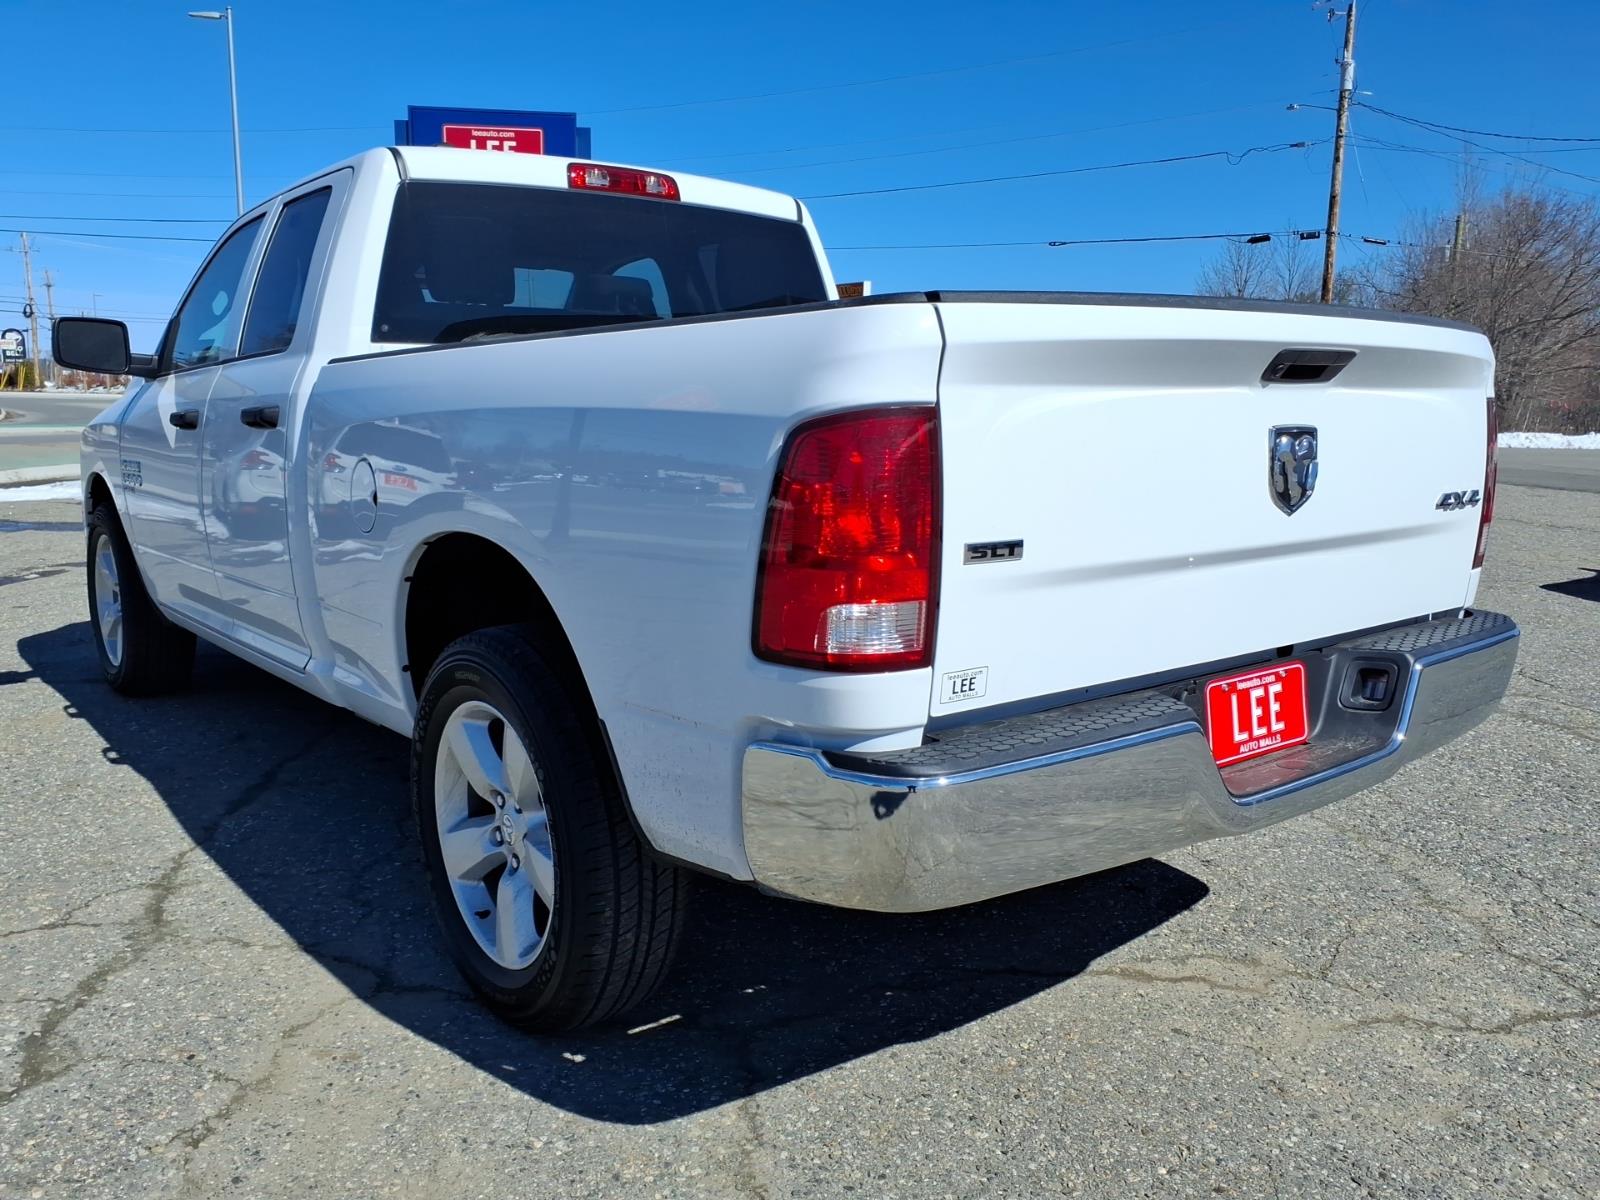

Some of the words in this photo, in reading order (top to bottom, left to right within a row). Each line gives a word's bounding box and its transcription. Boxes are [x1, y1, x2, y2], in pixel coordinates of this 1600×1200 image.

[471, 129, 515, 137] leeauto.com
[967, 542, 1020, 560] SLT
[952, 676, 976, 694] LEE
[1231, 682, 1285, 742] LEE
[1239, 741, 1259, 753] AUTO
[1259, 734, 1281, 748] MALLS
